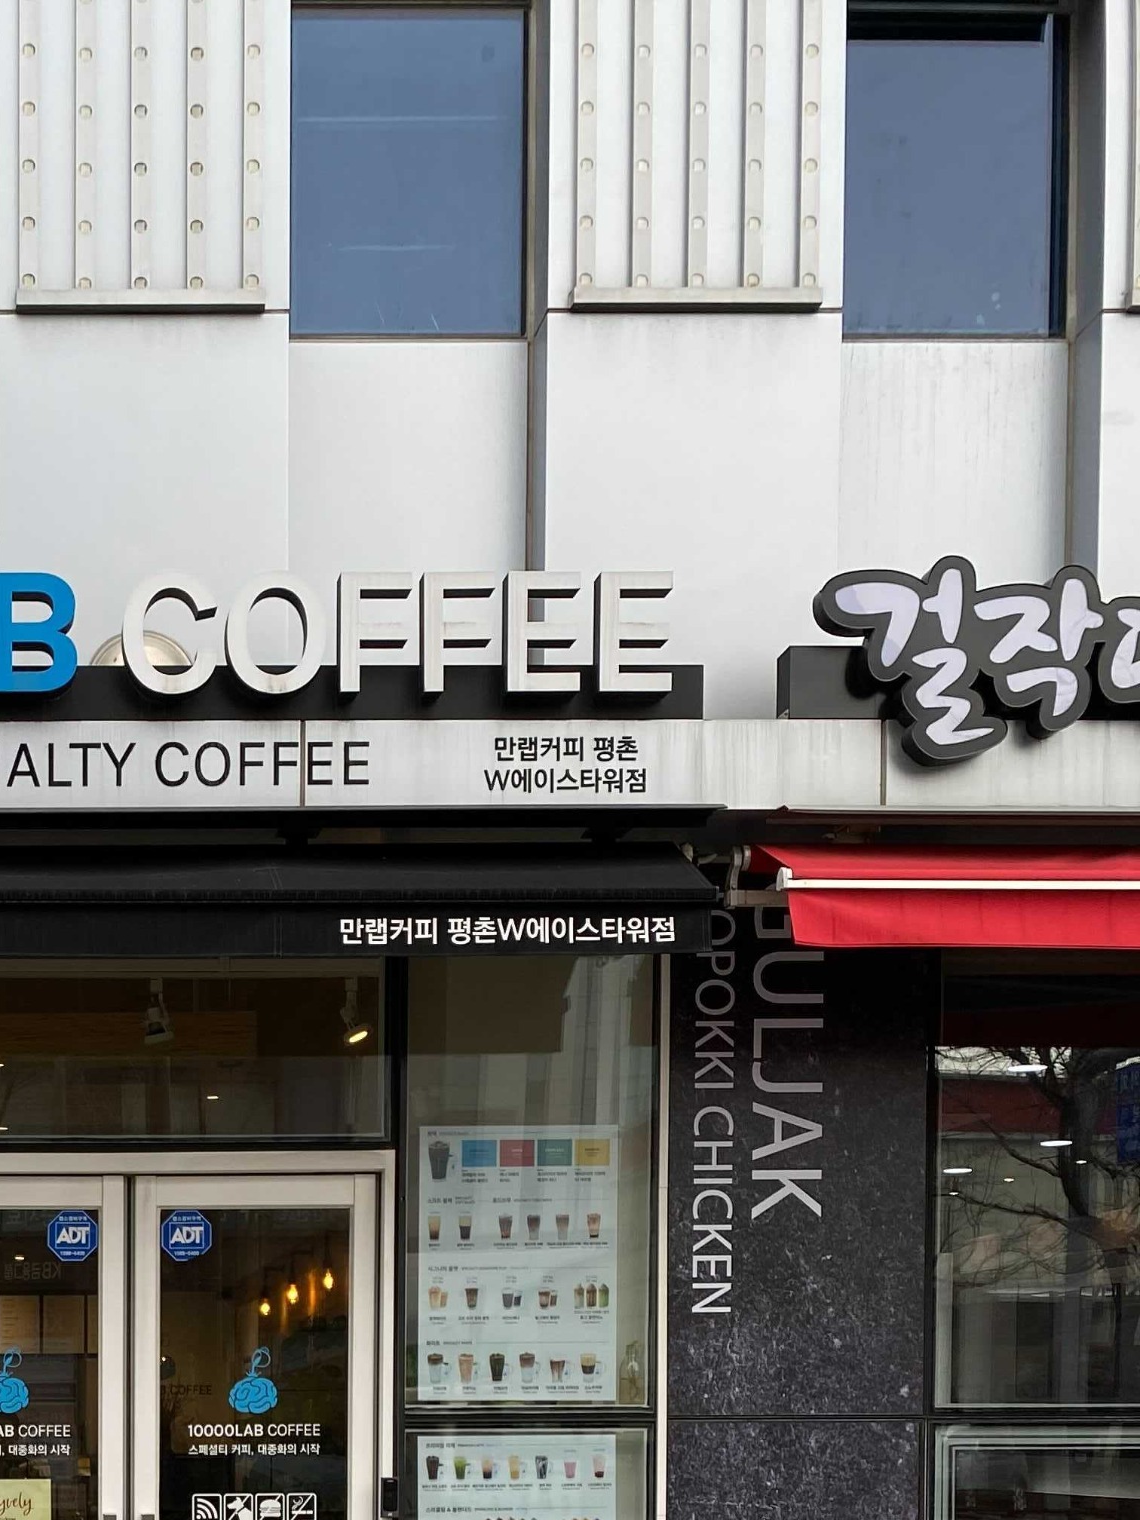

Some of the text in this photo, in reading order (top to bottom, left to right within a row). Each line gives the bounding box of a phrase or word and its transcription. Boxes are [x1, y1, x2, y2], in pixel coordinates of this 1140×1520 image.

[121, 570, 674, 697] COFFEE
[493, 736, 639, 764] 만랩커피 평촌
[154, 741, 370, 787] COFFEE
[484, 767, 647, 794] W에이스타워점
[339, 916, 676, 946] 만랩커피 평촌W에이스타워점
[691, 909, 736, 1314] OPOKKI CHICKEN
[56, 1226, 90, 1244] ADT
[170, 1226, 204, 1244] ADT
[18, 1424, 72, 1438] COFFEE
[187, 1423, 321, 1437] 10000LAB COFFEE
[8, 1444, 48, 1457] 대중화의
[50, 1444, 71, 1457] 시작
[230, 1444, 255, 1457] 커피,
[257, 1443, 298, 1456] 대중화의
[300, 1443, 321, 1456] 시작
